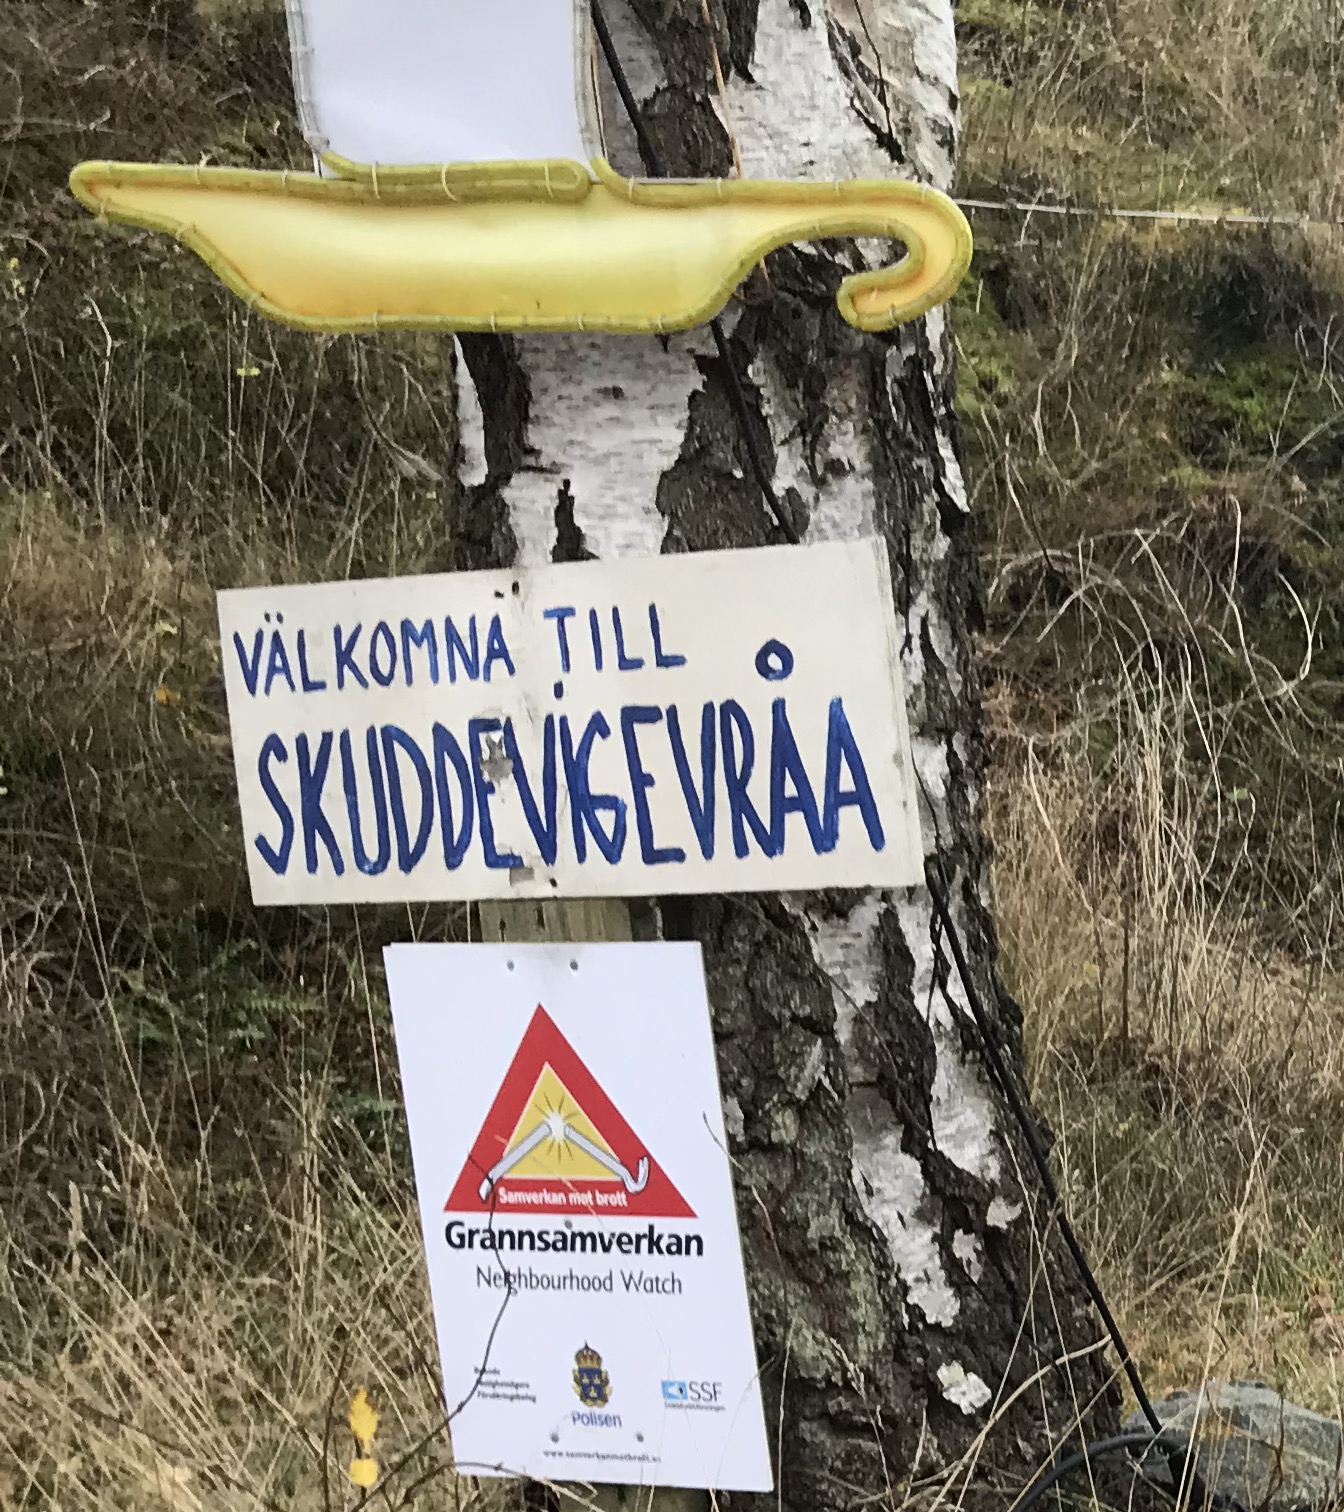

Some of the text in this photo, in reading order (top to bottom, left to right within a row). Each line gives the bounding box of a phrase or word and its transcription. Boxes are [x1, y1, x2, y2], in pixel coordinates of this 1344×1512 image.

[233, 603, 687, 697] VÄLKOMNA TILL
[498, 1187, 628, 1208] Samverkan mot brott
[445, 1221, 704, 1257] Grannsamverkan
[476, 1265, 683, 1297] Neighbourhood Watch
[688, 1380, 723, 1402] SSF
[571, 1410, 623, 1428] Polisen
